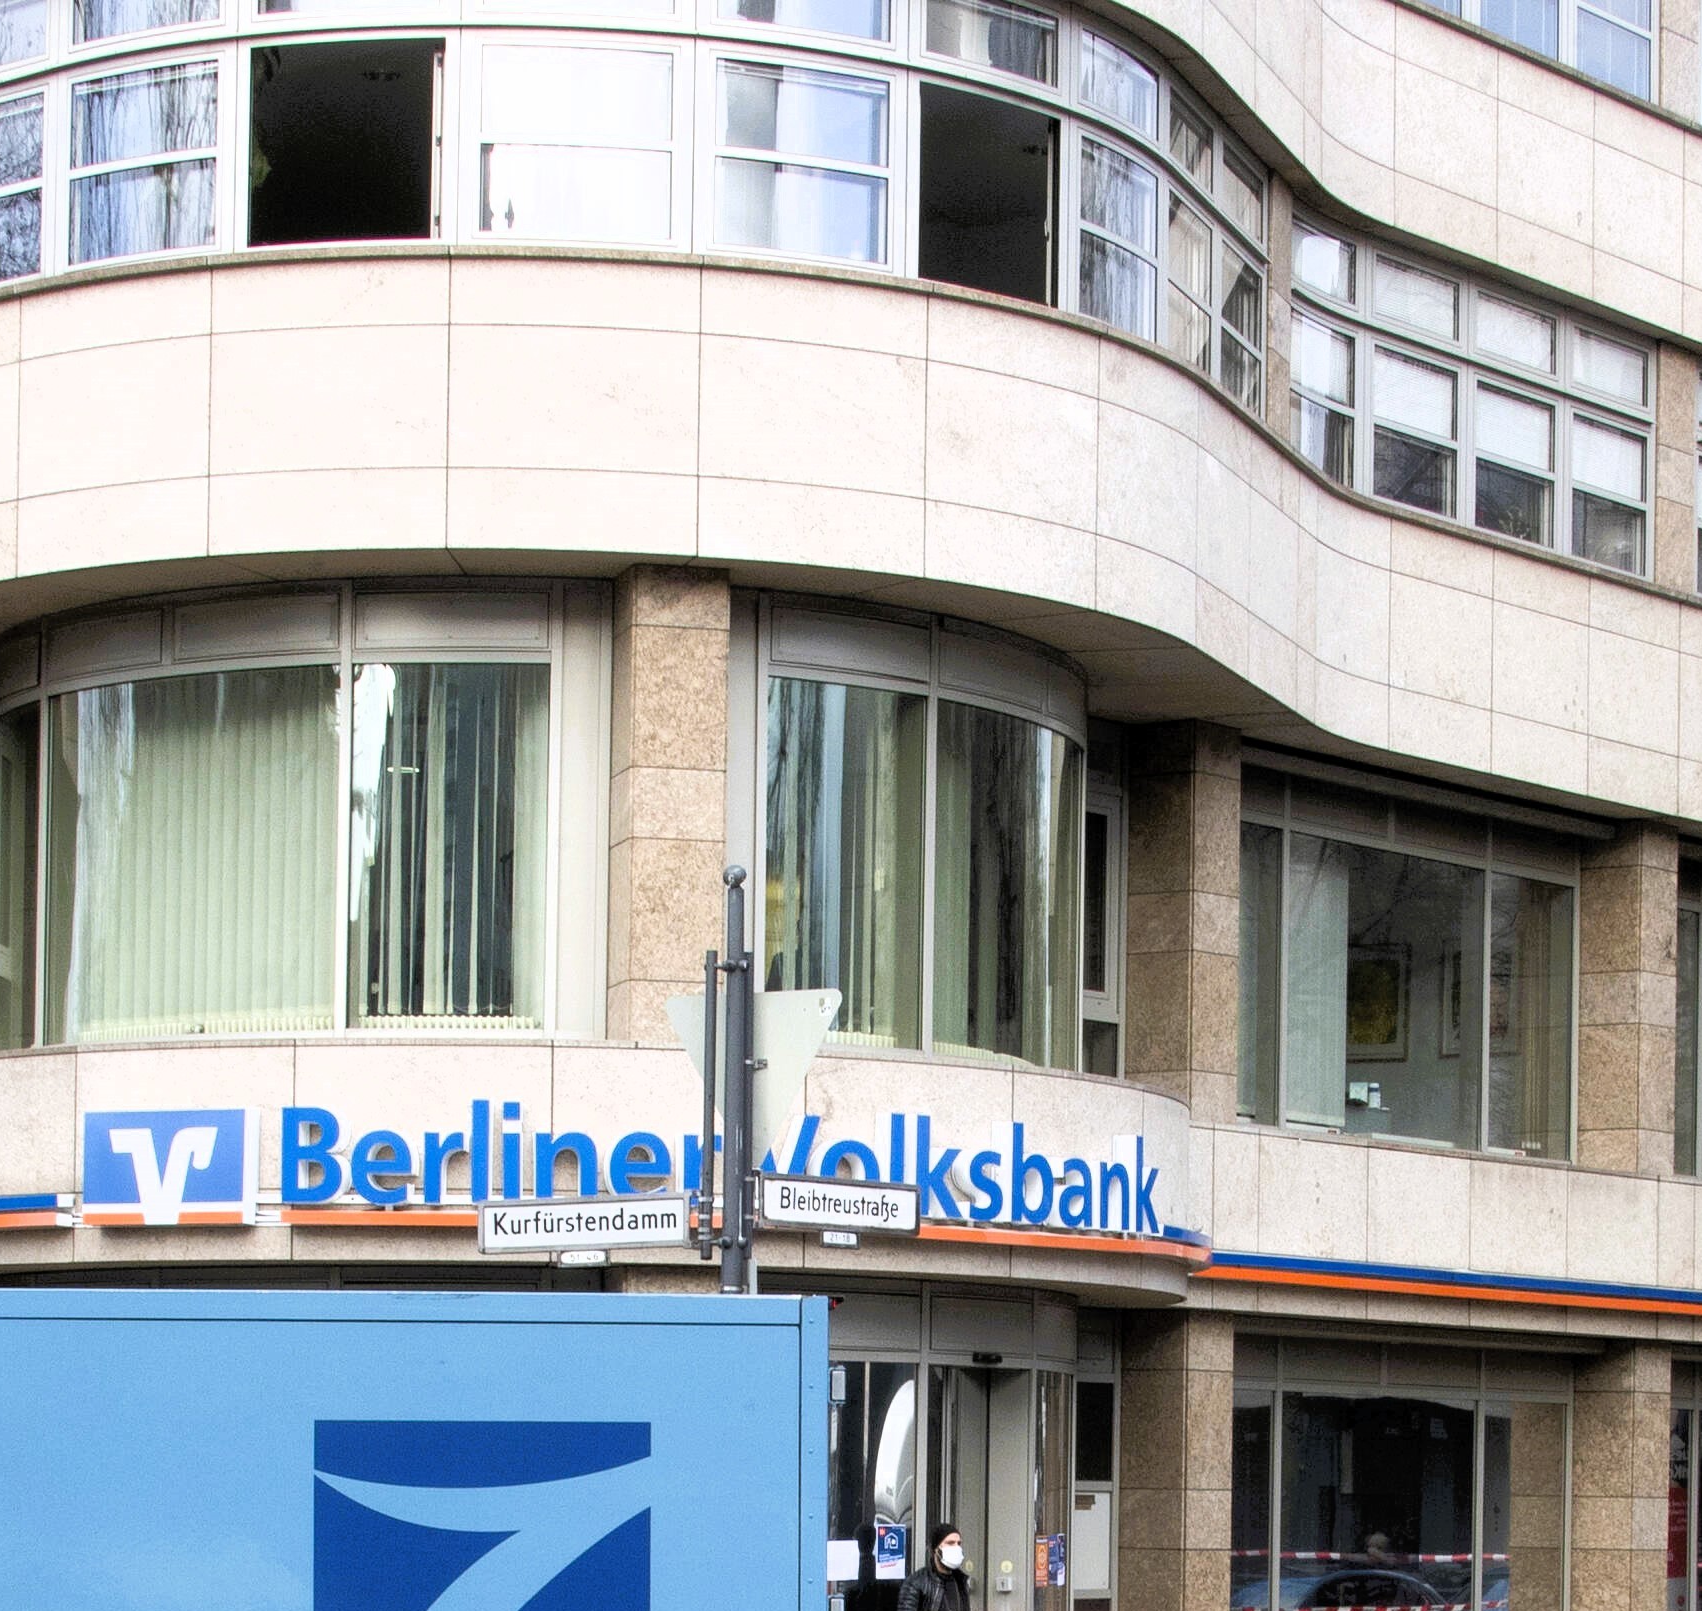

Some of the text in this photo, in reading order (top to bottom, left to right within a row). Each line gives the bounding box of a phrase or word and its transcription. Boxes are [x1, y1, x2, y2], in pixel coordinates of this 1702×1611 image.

[281, 1100, 723, 1204] Berliner
[779, 1186, 899, 1221] Bleibtreustraße
[493, 1208, 678, 1236] Kurfürstendamm
